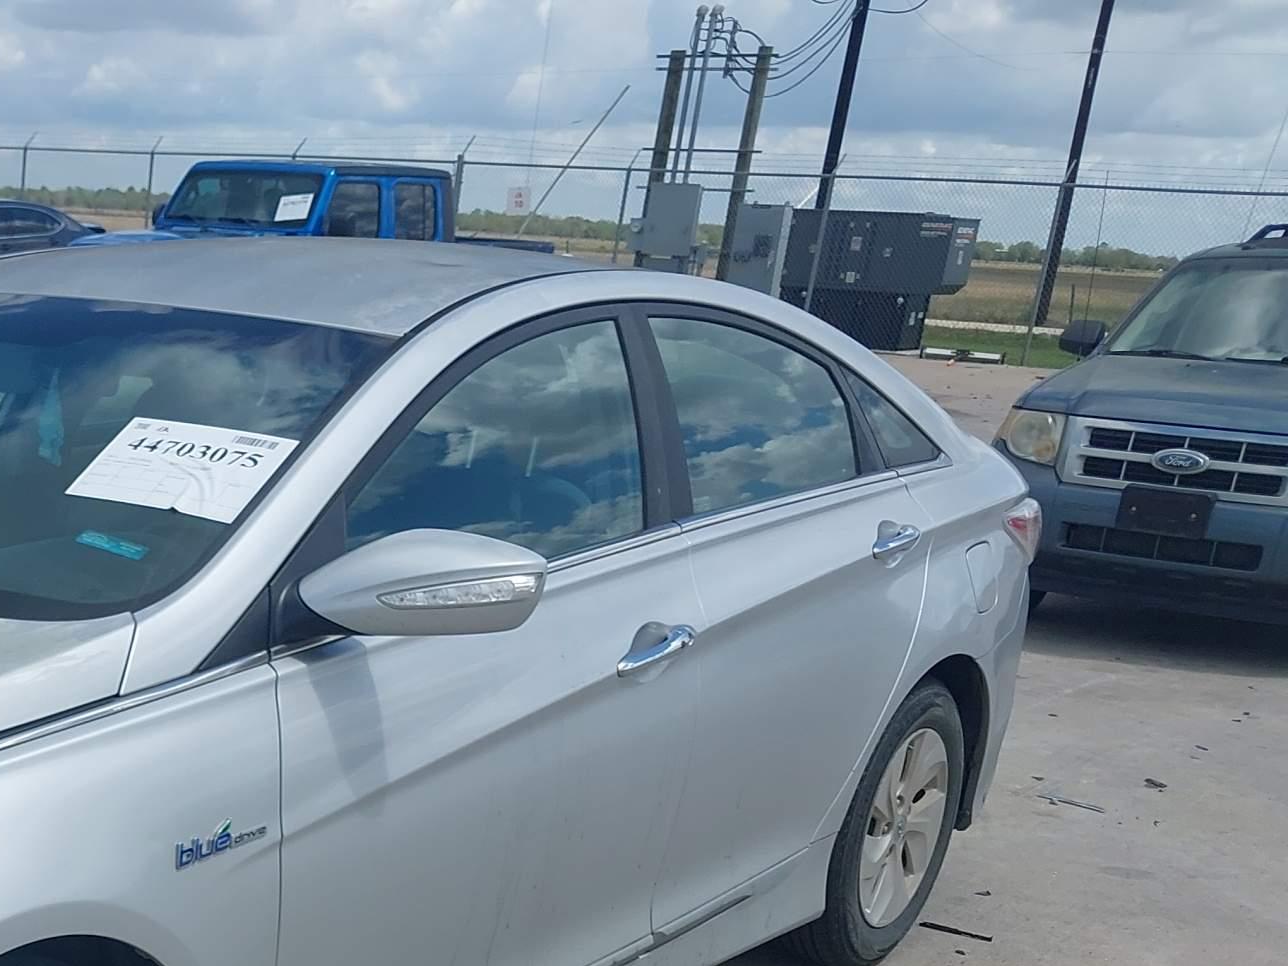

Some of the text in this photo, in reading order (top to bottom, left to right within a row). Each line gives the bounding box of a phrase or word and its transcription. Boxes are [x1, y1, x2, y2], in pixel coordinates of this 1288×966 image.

[127, 436, 265, 469] 44703075
[1164, 454, 1193, 467] Ford
[175, 822, 268, 871] blue drive
